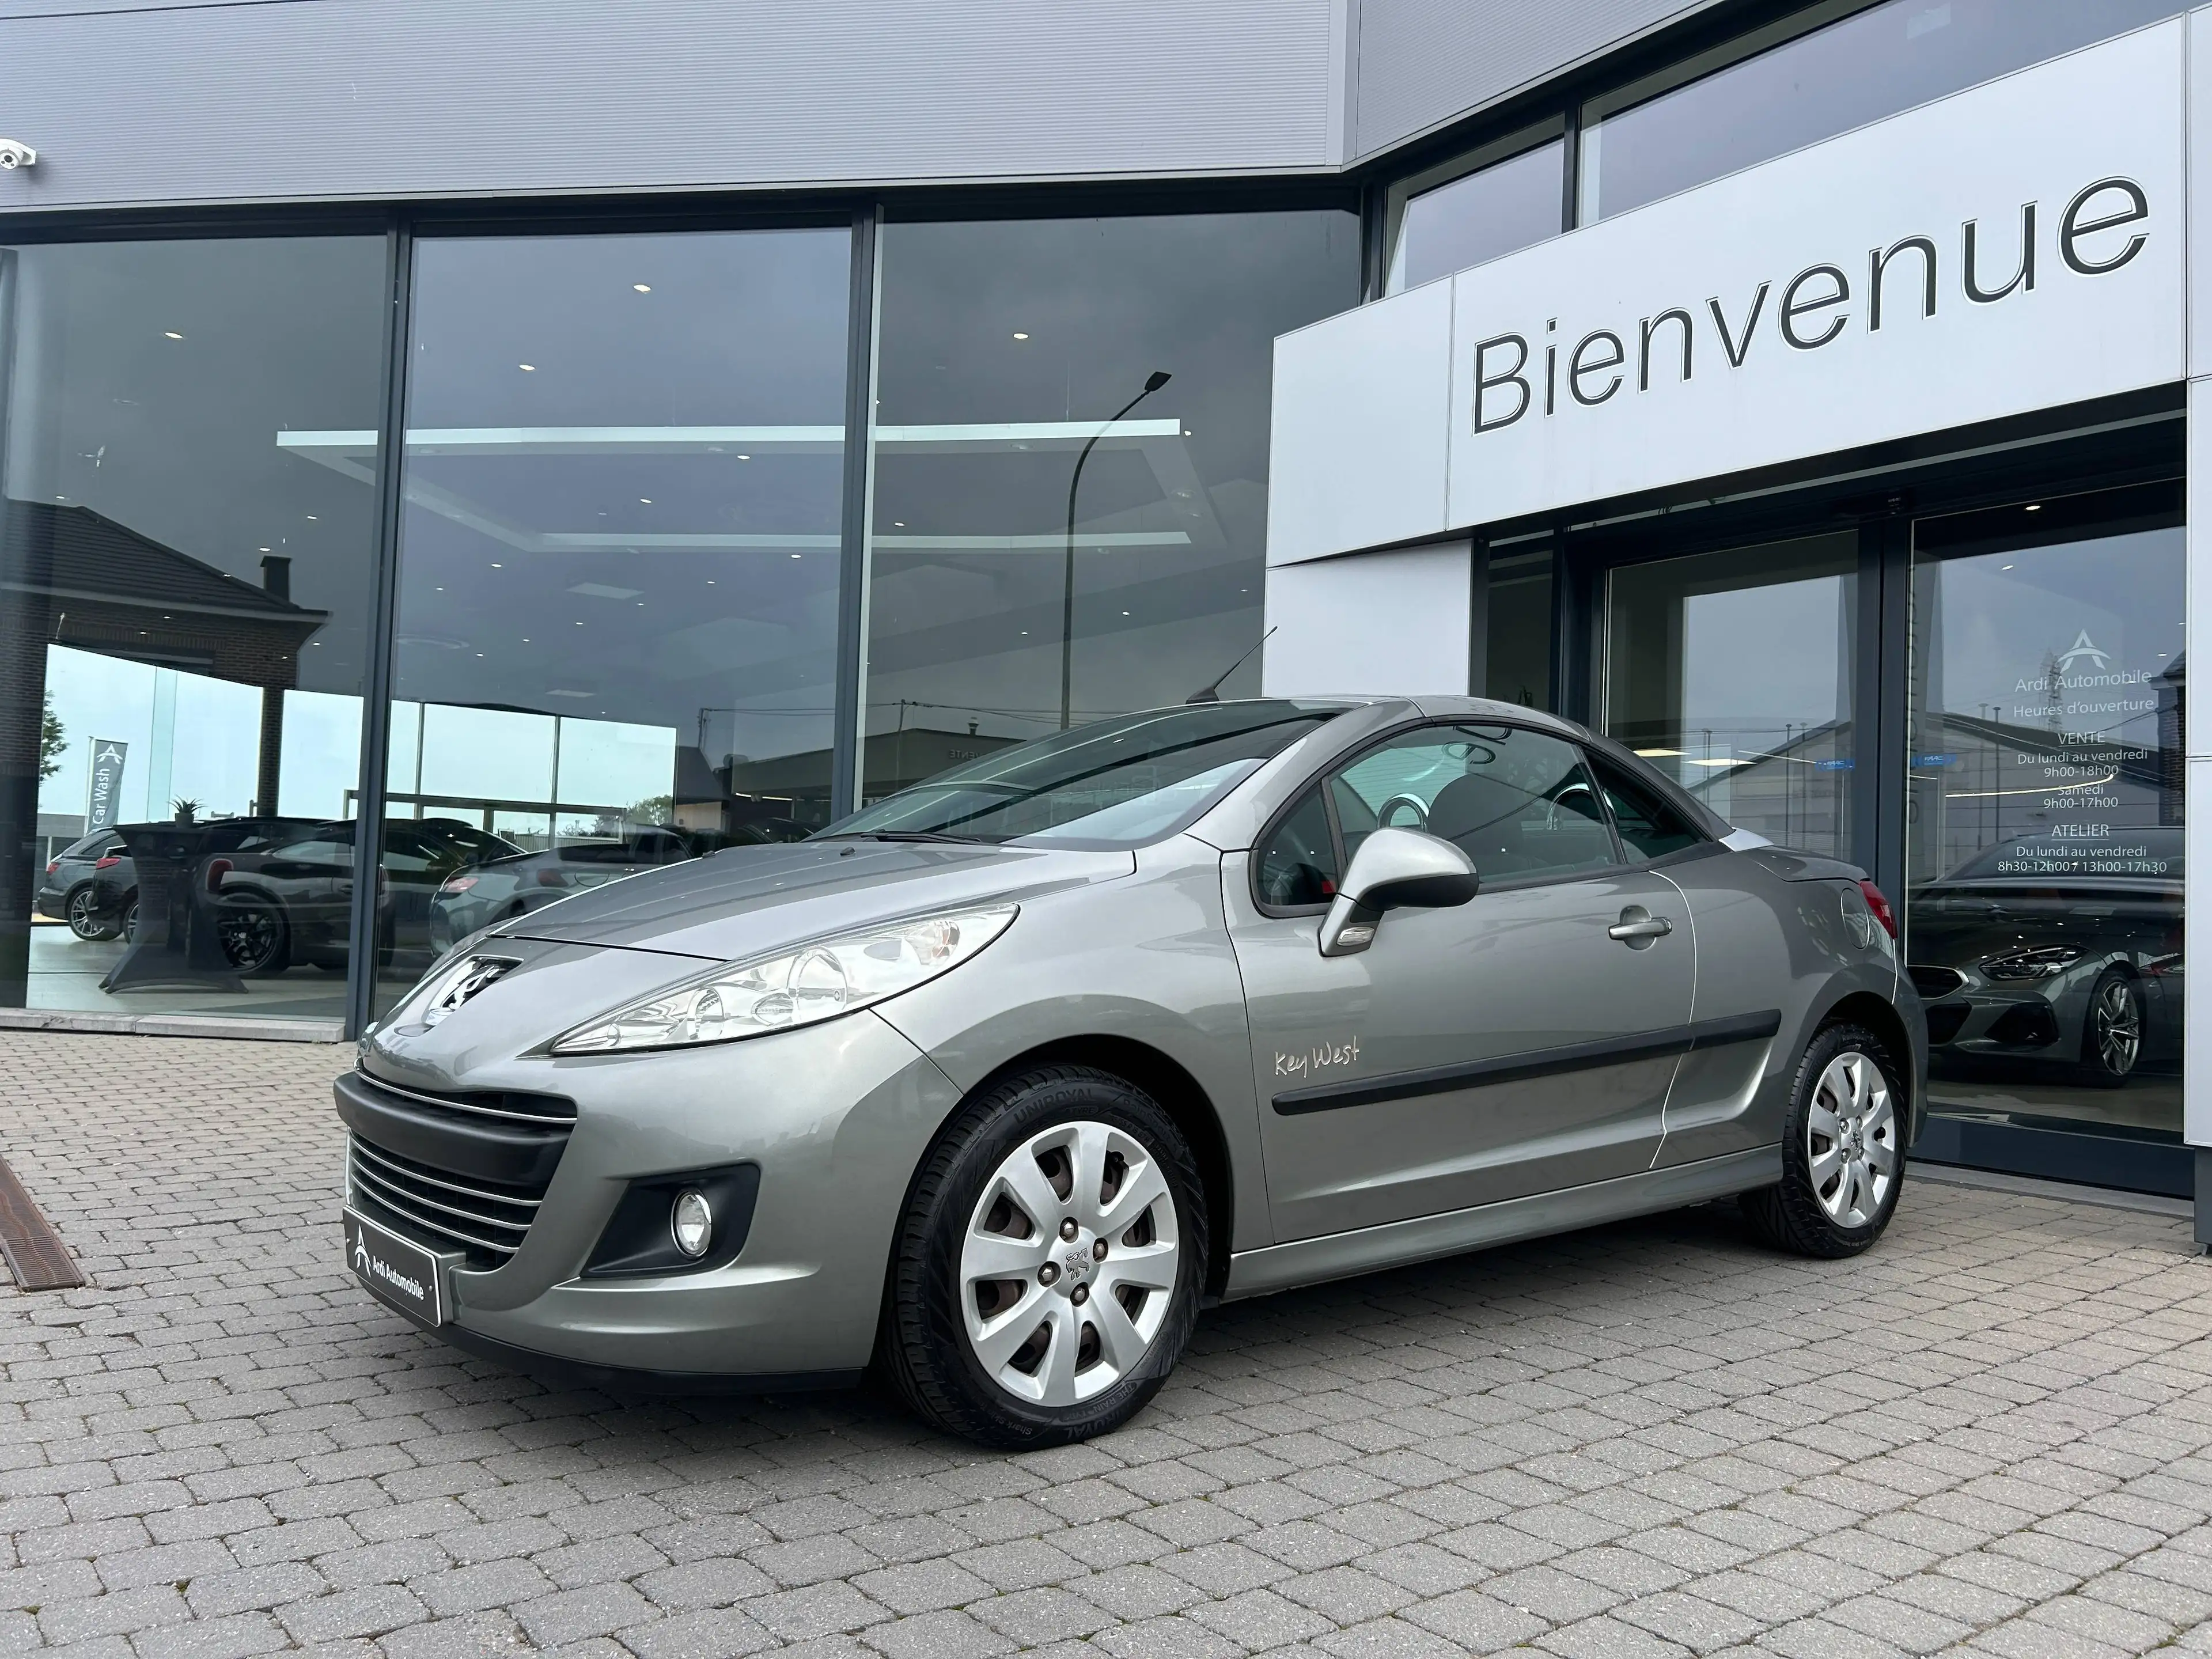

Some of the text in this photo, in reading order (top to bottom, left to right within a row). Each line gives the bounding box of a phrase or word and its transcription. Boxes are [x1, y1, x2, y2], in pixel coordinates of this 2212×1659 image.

[1472, 176, 2149, 436] Bienvenue
[2015, 670, 2152, 692] Ardi Automobile
[2014, 704, 2063, 718] Heures
[2058, 731, 2105, 745] VENTE
[2018, 749, 2148, 765] Du lundi au vendredi
[2043, 764, 2119, 778] 9h00-18h00
[92, 768, 111, 824] Car Wash
[2057, 784, 2104, 796] Samedi
[2043, 797, 2119, 809] 9h00-17h00
[2051, 824, 2109, 837] ATELIER
[2016, 845, 2147, 858] Du lundi au vendredi
[1997, 861, 2070, 872] 8h30-12h00
[2082, 861, 2167, 873] 13h00-17h30
[1274, 1035, 1360, 1078] Key West
[1013, 1088, 1096, 1124] UNIROYAL
[373, 1255, 425, 1300] Ardi Automobile
[1115, 1383, 1134, 1401] THE
[1093, 1396, 1116, 1412] RAIN
[1005, 1420, 1031, 1435] Shark
